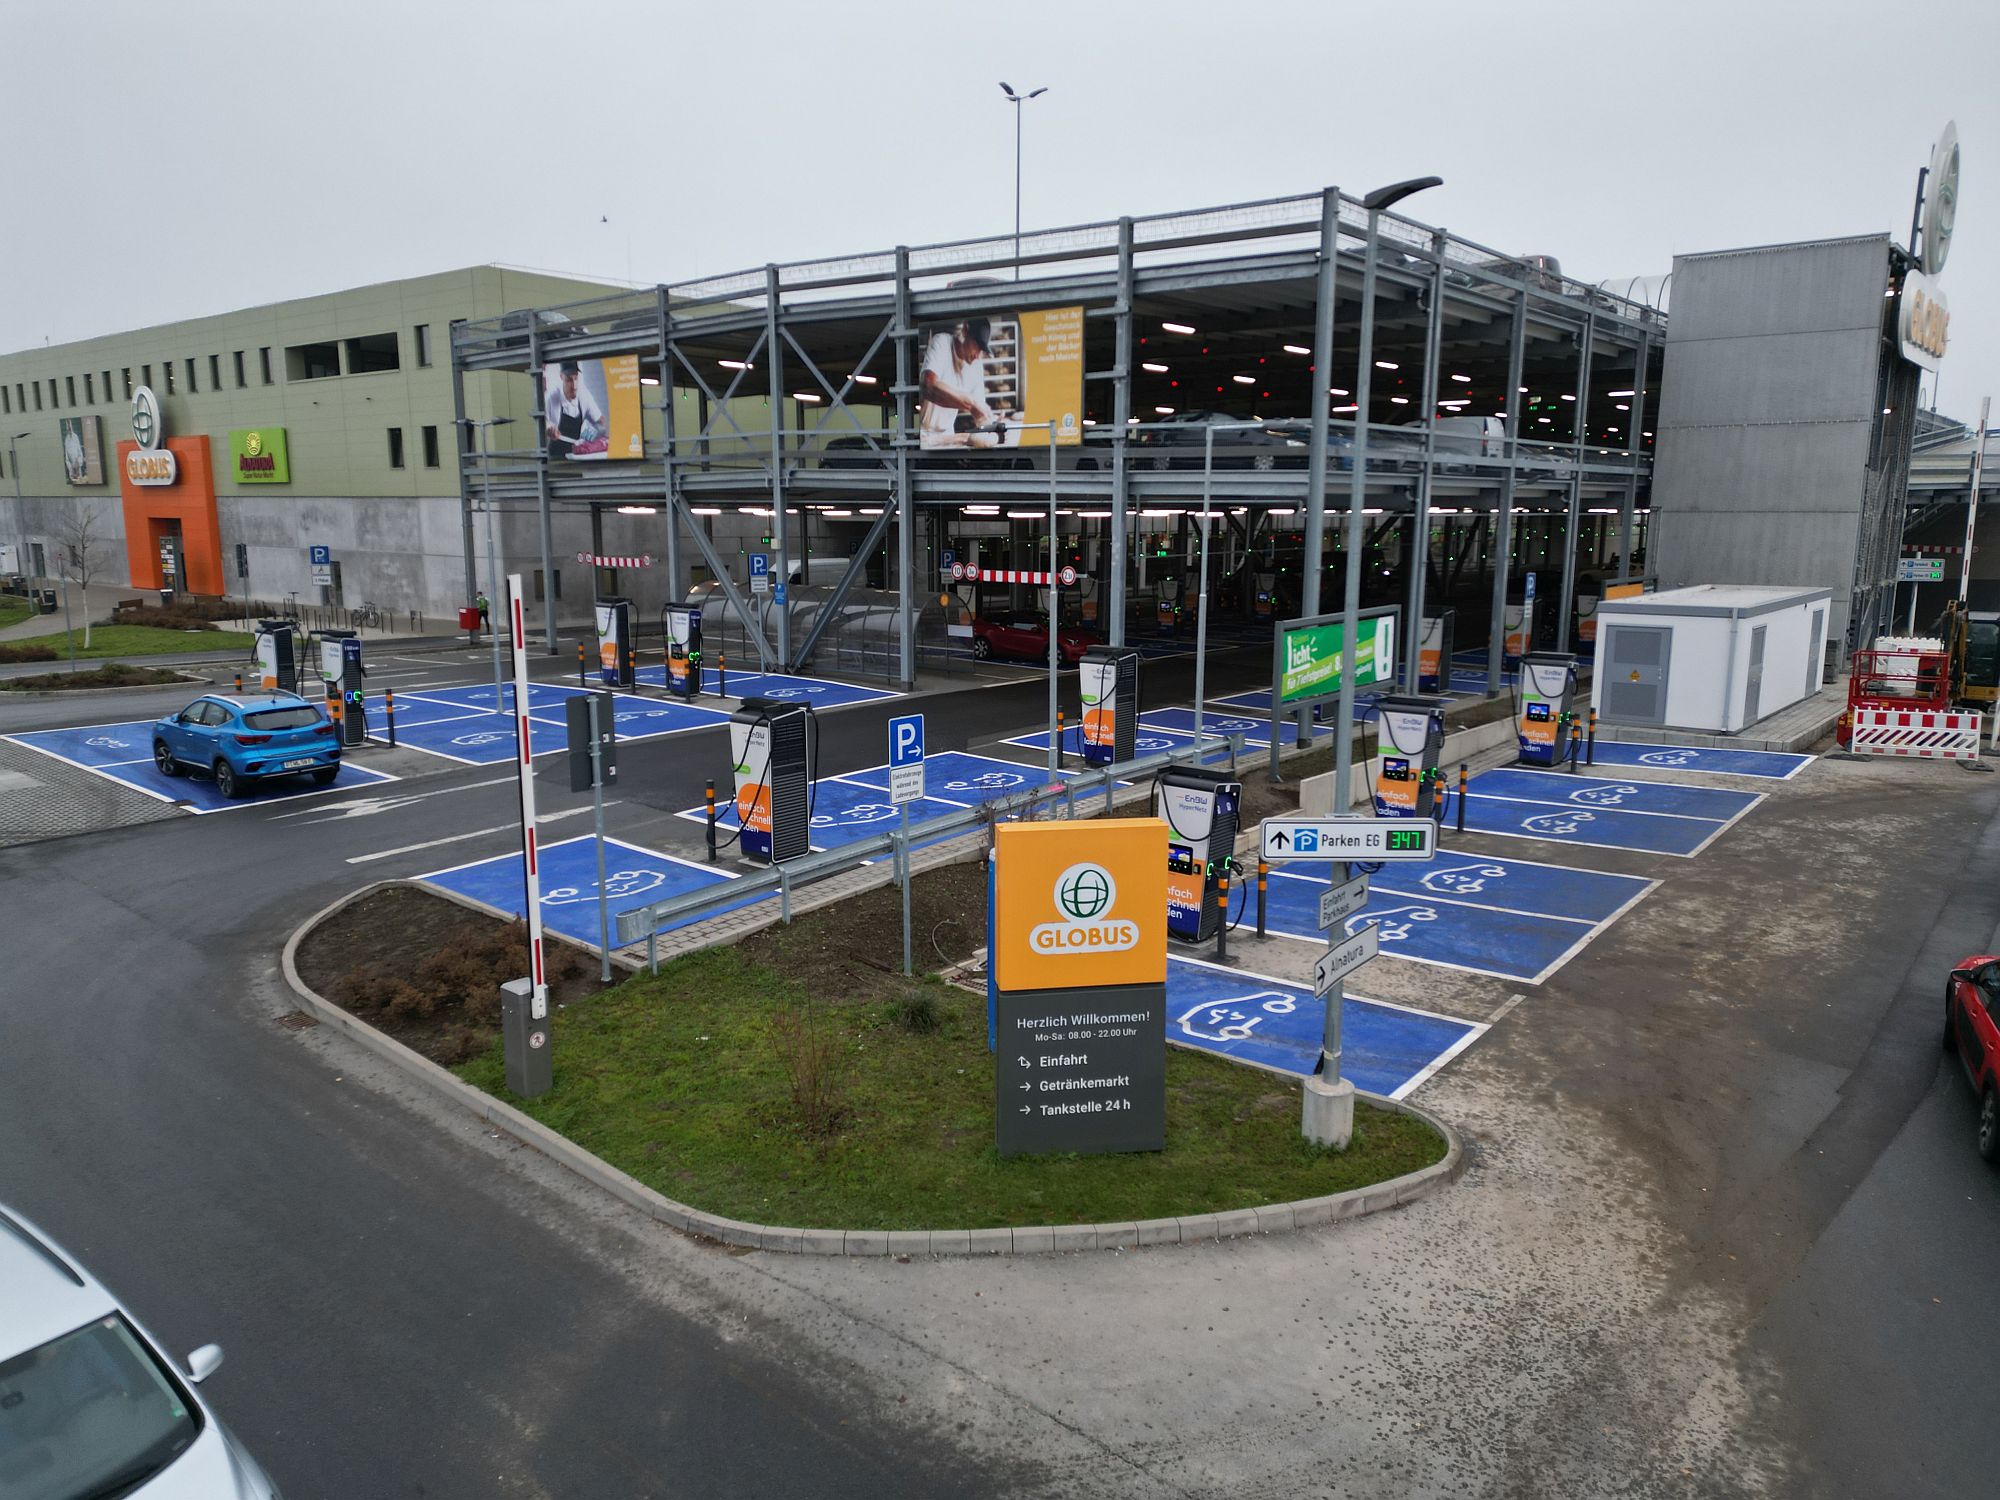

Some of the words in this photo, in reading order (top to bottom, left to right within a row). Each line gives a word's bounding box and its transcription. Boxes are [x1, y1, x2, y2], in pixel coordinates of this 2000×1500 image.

[1912, 289, 1950, 356] GLOBUS
[128, 457, 170, 478] GLOBUS
[754, 557, 764, 574] P
[1287, 636, 1311, 676] Licht
[898, 724, 916, 760] P
[1184, 794, 1208, 804] EnBW
[1322, 834, 1360, 847] Parken
[1366, 834, 1380, 847] EG
[1391, 832, 1420, 848] 347
[1323, 903, 1350, 923] Parkhaus
[1036, 926, 1132, 949] GLOBUS
[1330, 945, 1364, 976] Alnatura
[1017, 1016, 1067, 1029] Herzlich
[1071, 1011, 1150, 1026] Willkommen!
[1035, 1032, 1066, 1042] Mo-Sa:
[1068, 1030, 1092, 1040] 08.00
[1098, 1029, 1121, 1038] 22.00
[1122, 1028, 1137, 1036] Uhr
[1040, 1054, 1088, 1068] Einfahrt
[1040, 1076, 1130, 1092] Getränkemarkt
[1040, 1101, 1102, 1116] Tankstelle
[1106, 1100, 1120, 1112] 24
[1124, 1098, 1131, 1110] h
